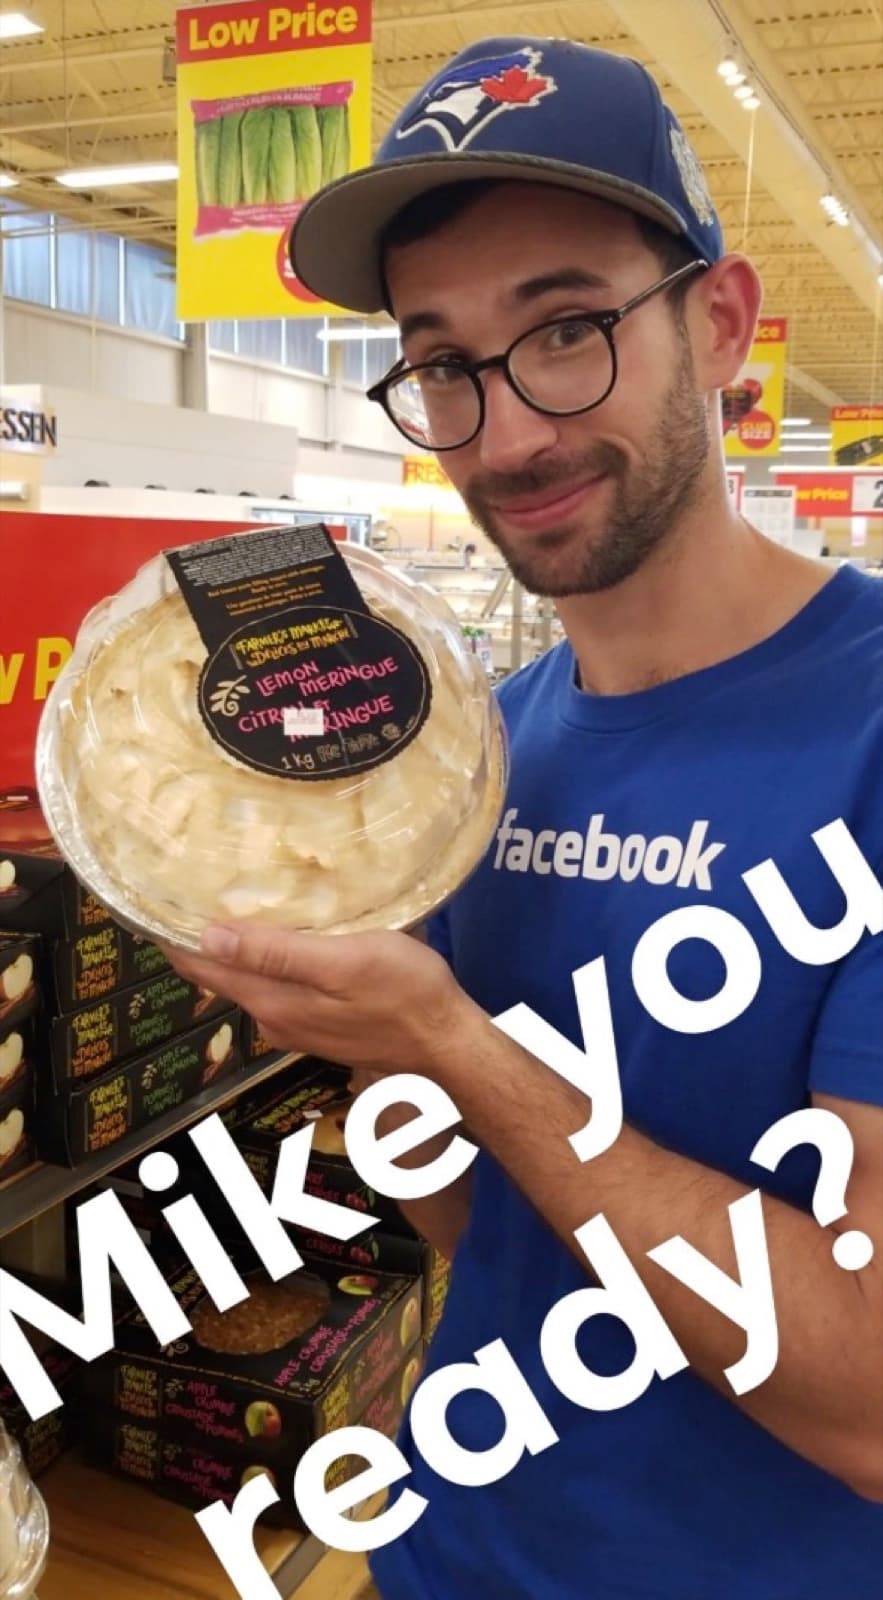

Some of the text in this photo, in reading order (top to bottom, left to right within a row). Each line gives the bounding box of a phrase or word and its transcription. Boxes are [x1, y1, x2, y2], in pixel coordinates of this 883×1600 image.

[189, 4, 358, 51] Low Price
[0, 407, 57, 447] SSEN
[811, 487, 849, 502] Price
[256, 660, 320, 697] LEMON
[238, 701, 305, 733] CITR
[281, 756, 292, 770] 1
[493, 808, 727, 891] facebook
